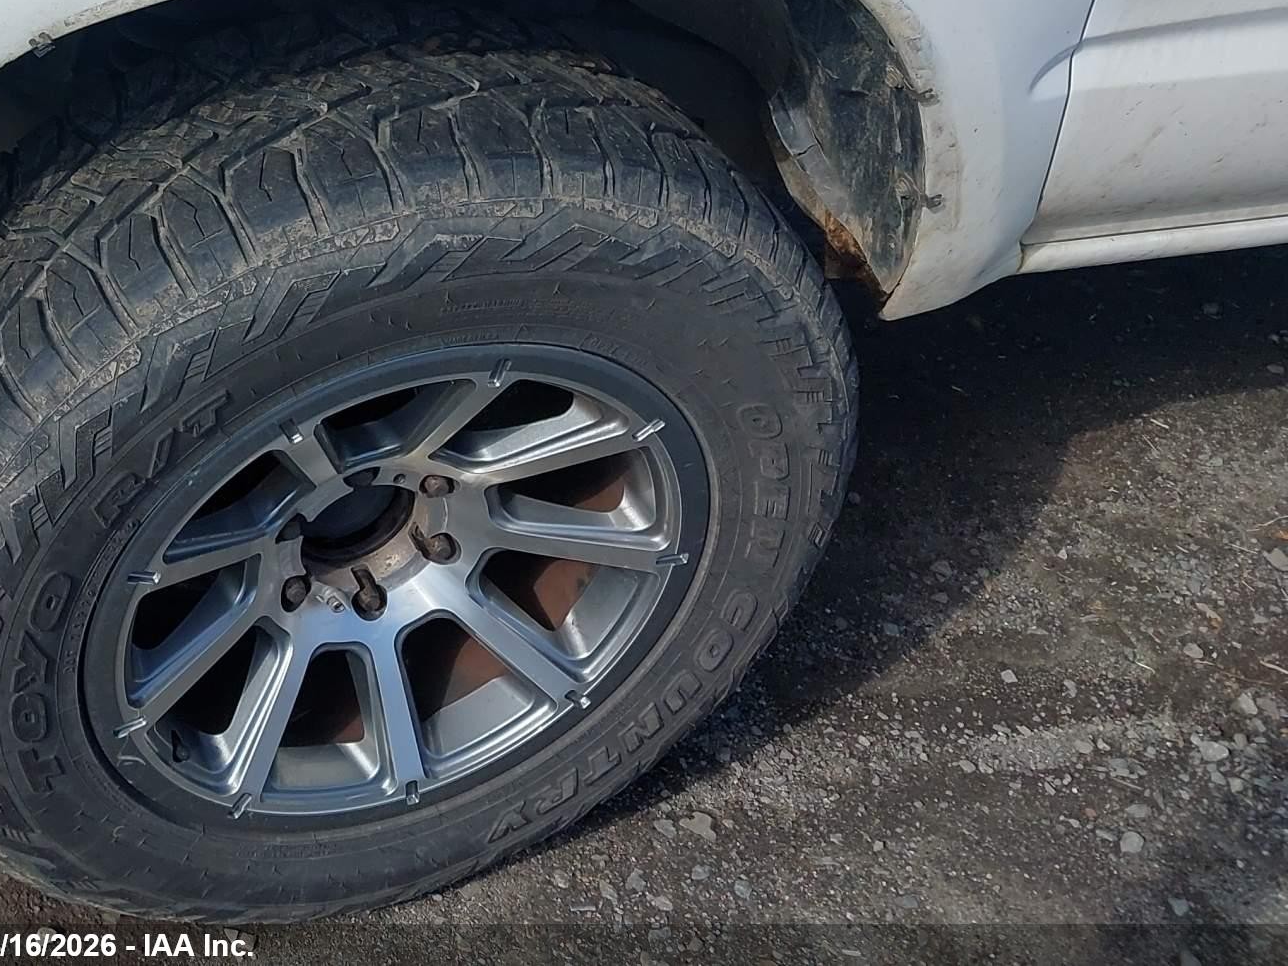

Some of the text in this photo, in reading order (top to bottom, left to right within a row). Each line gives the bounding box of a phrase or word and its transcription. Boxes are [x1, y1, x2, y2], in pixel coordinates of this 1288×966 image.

[10, 572, 74, 795] TOYO
[487, 404, 791, 843] OPEN COUNTRY
